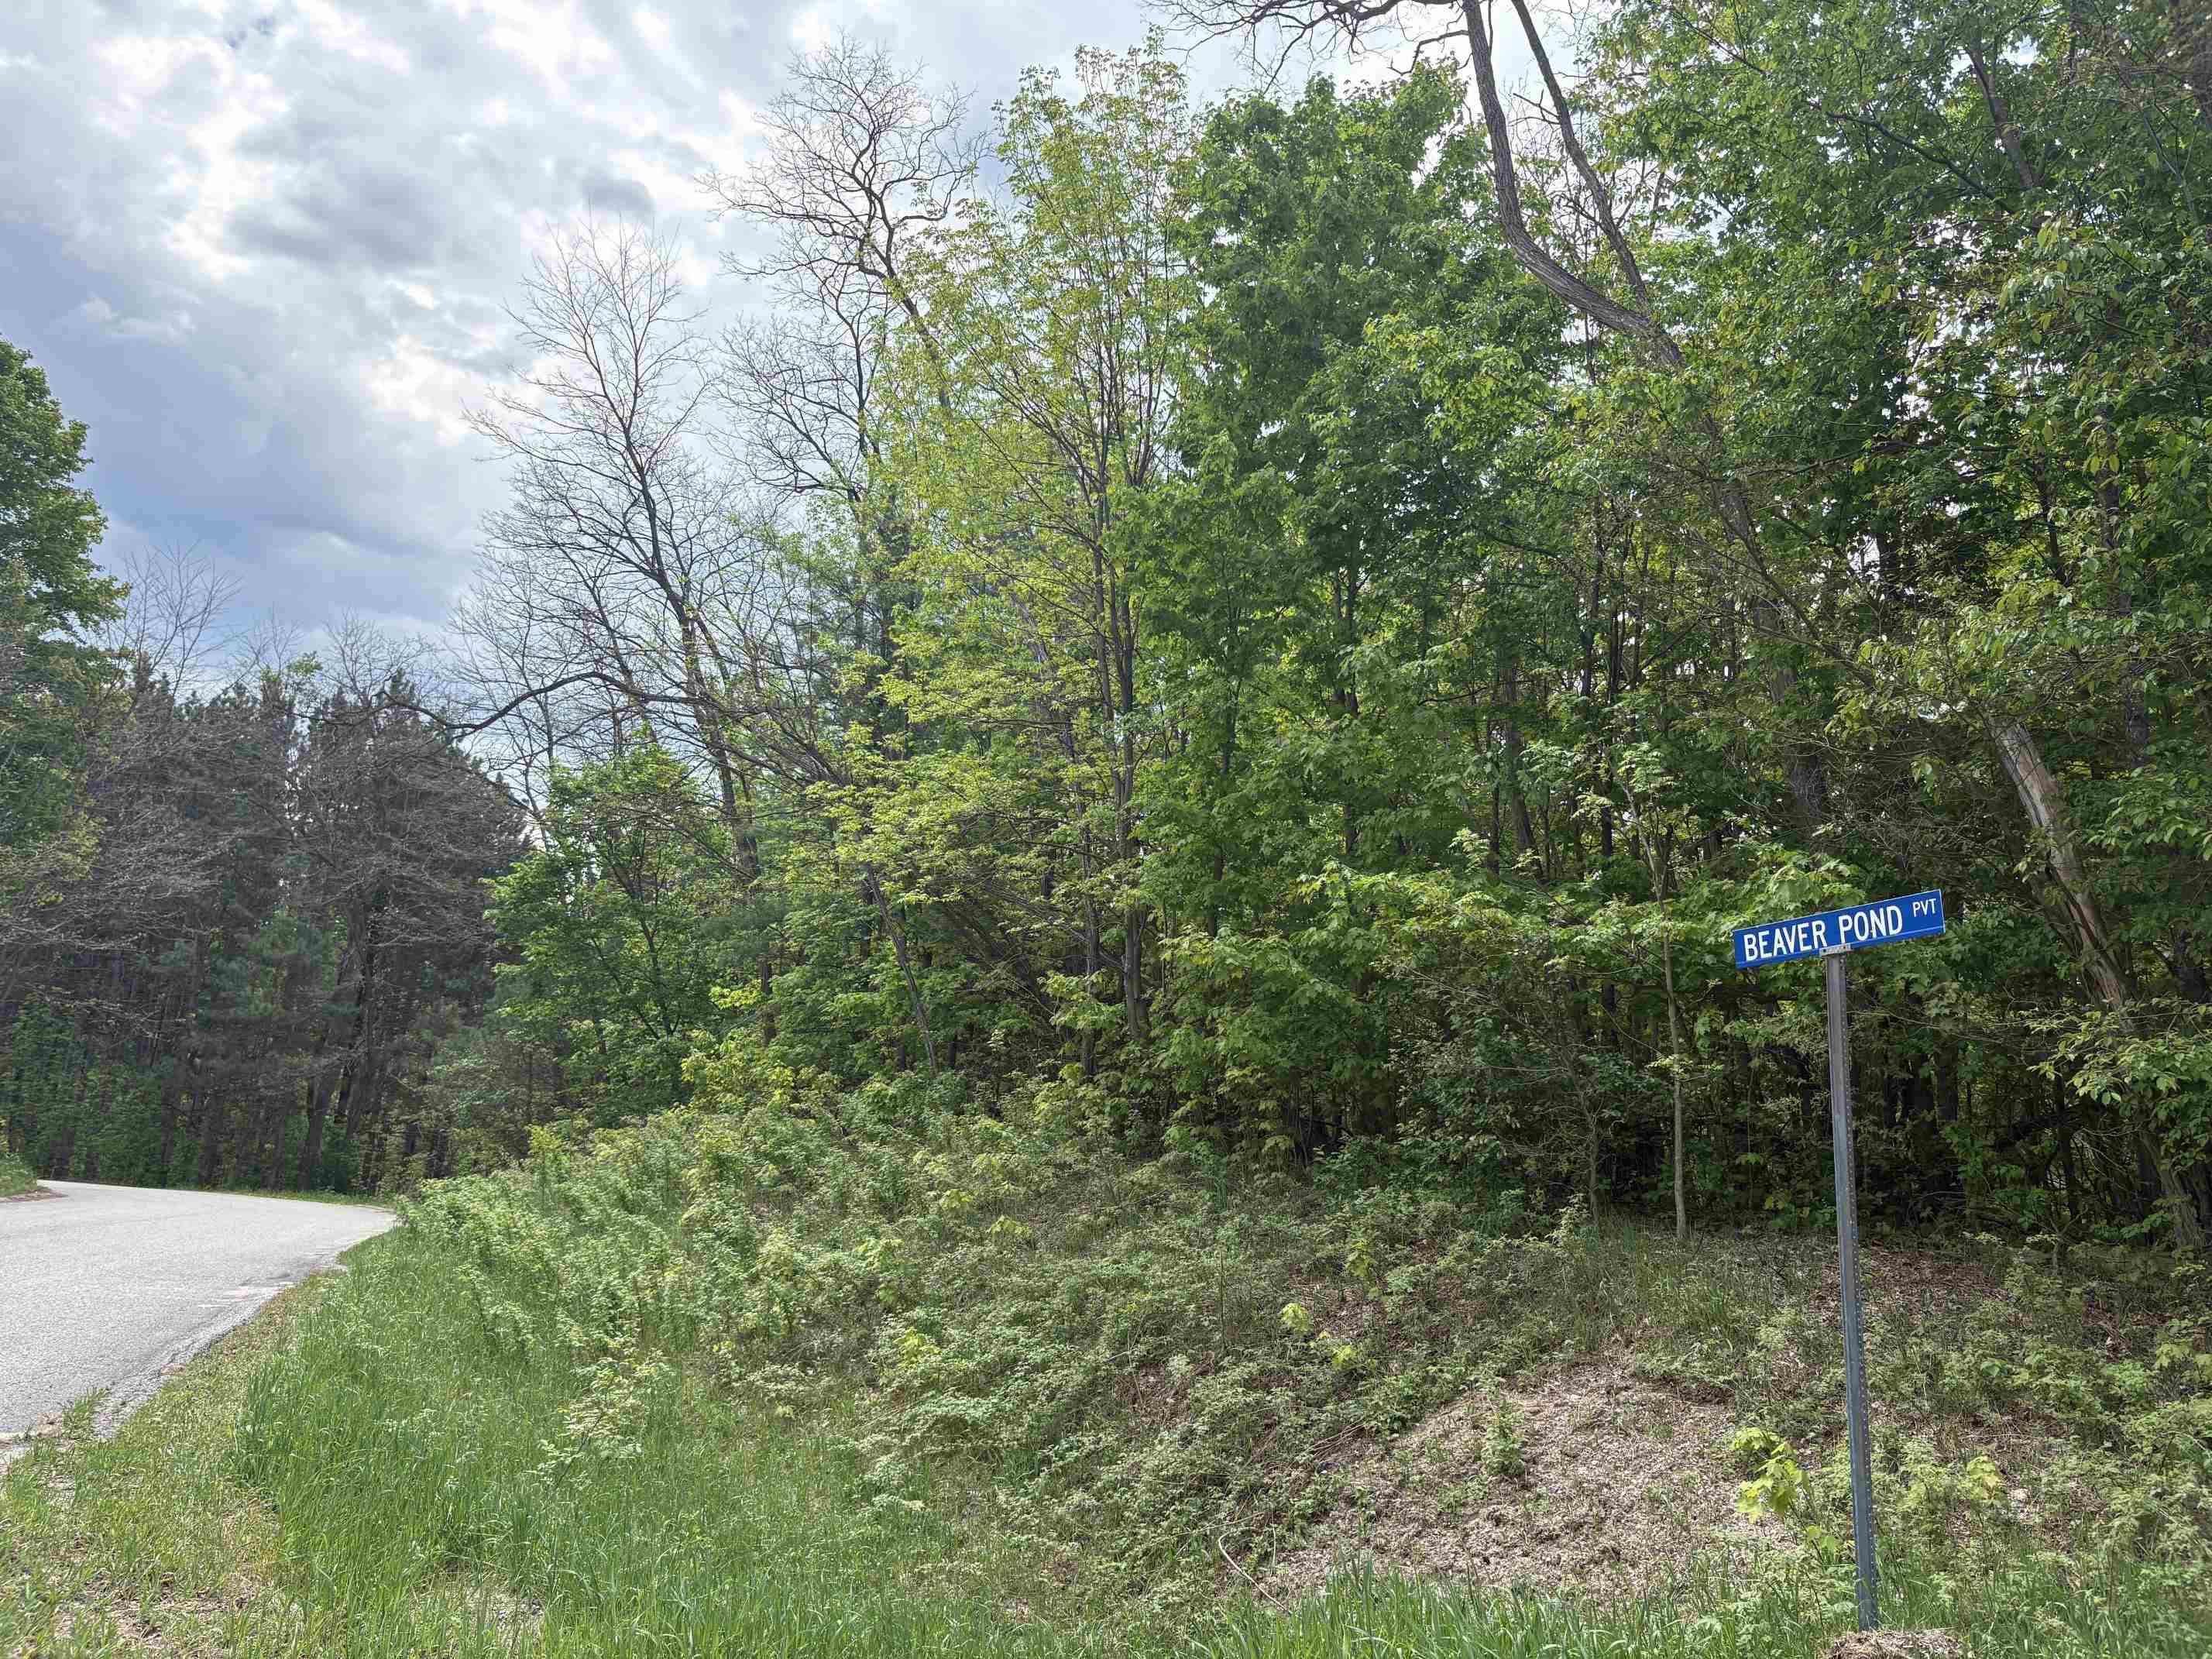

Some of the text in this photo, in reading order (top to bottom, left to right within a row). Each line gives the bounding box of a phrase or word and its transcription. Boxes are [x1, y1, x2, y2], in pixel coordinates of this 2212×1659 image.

[1743, 898, 1937, 961] BEAVER POND PVT
